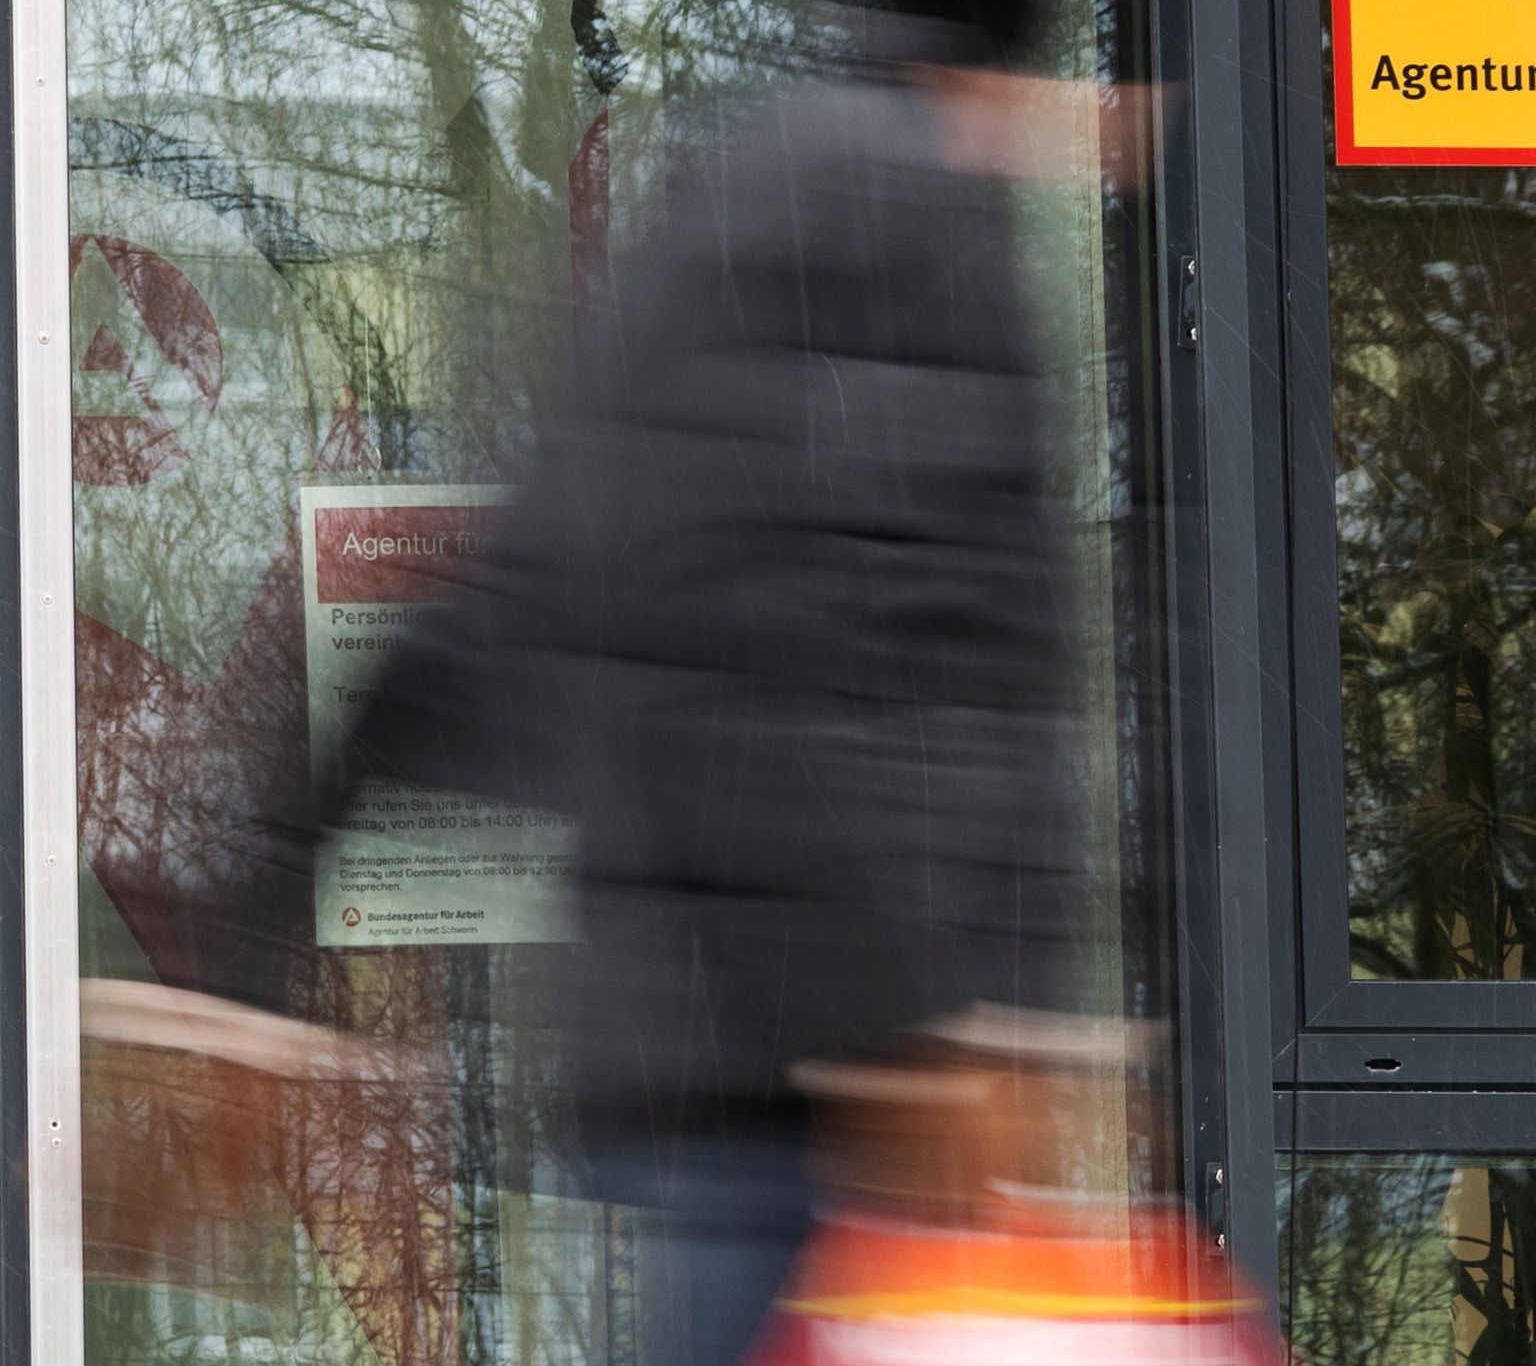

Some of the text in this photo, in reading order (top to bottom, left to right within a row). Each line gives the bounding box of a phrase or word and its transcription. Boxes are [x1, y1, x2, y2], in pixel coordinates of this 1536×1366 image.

[341, 530, 491, 561] Agentur für
[372, 800, 407, 812] rufen
[411, 799, 432, 812] Sie
[436, 802, 460, 812] uns
[390, 819, 415, 830] von
[418, 817, 457, 829] 08:00
[461, 815, 480, 828] bis
[485, 814, 523, 828] 14:00
[528, 814, 557, 829] Uhr)
[339, 856, 355, 866] Bei
[357, 856, 412, 867] dringenden
[414, 855, 456, 866] Anliegen
[500, 853, 544, 864] Wahrung
[384, 869, 404, 878] und
[406, 868, 461, 878] Donnerstag
[340, 883, 401, 894] vorsprechen.
[368, 909, 485, 923] Bundesagentur für Arbeit
